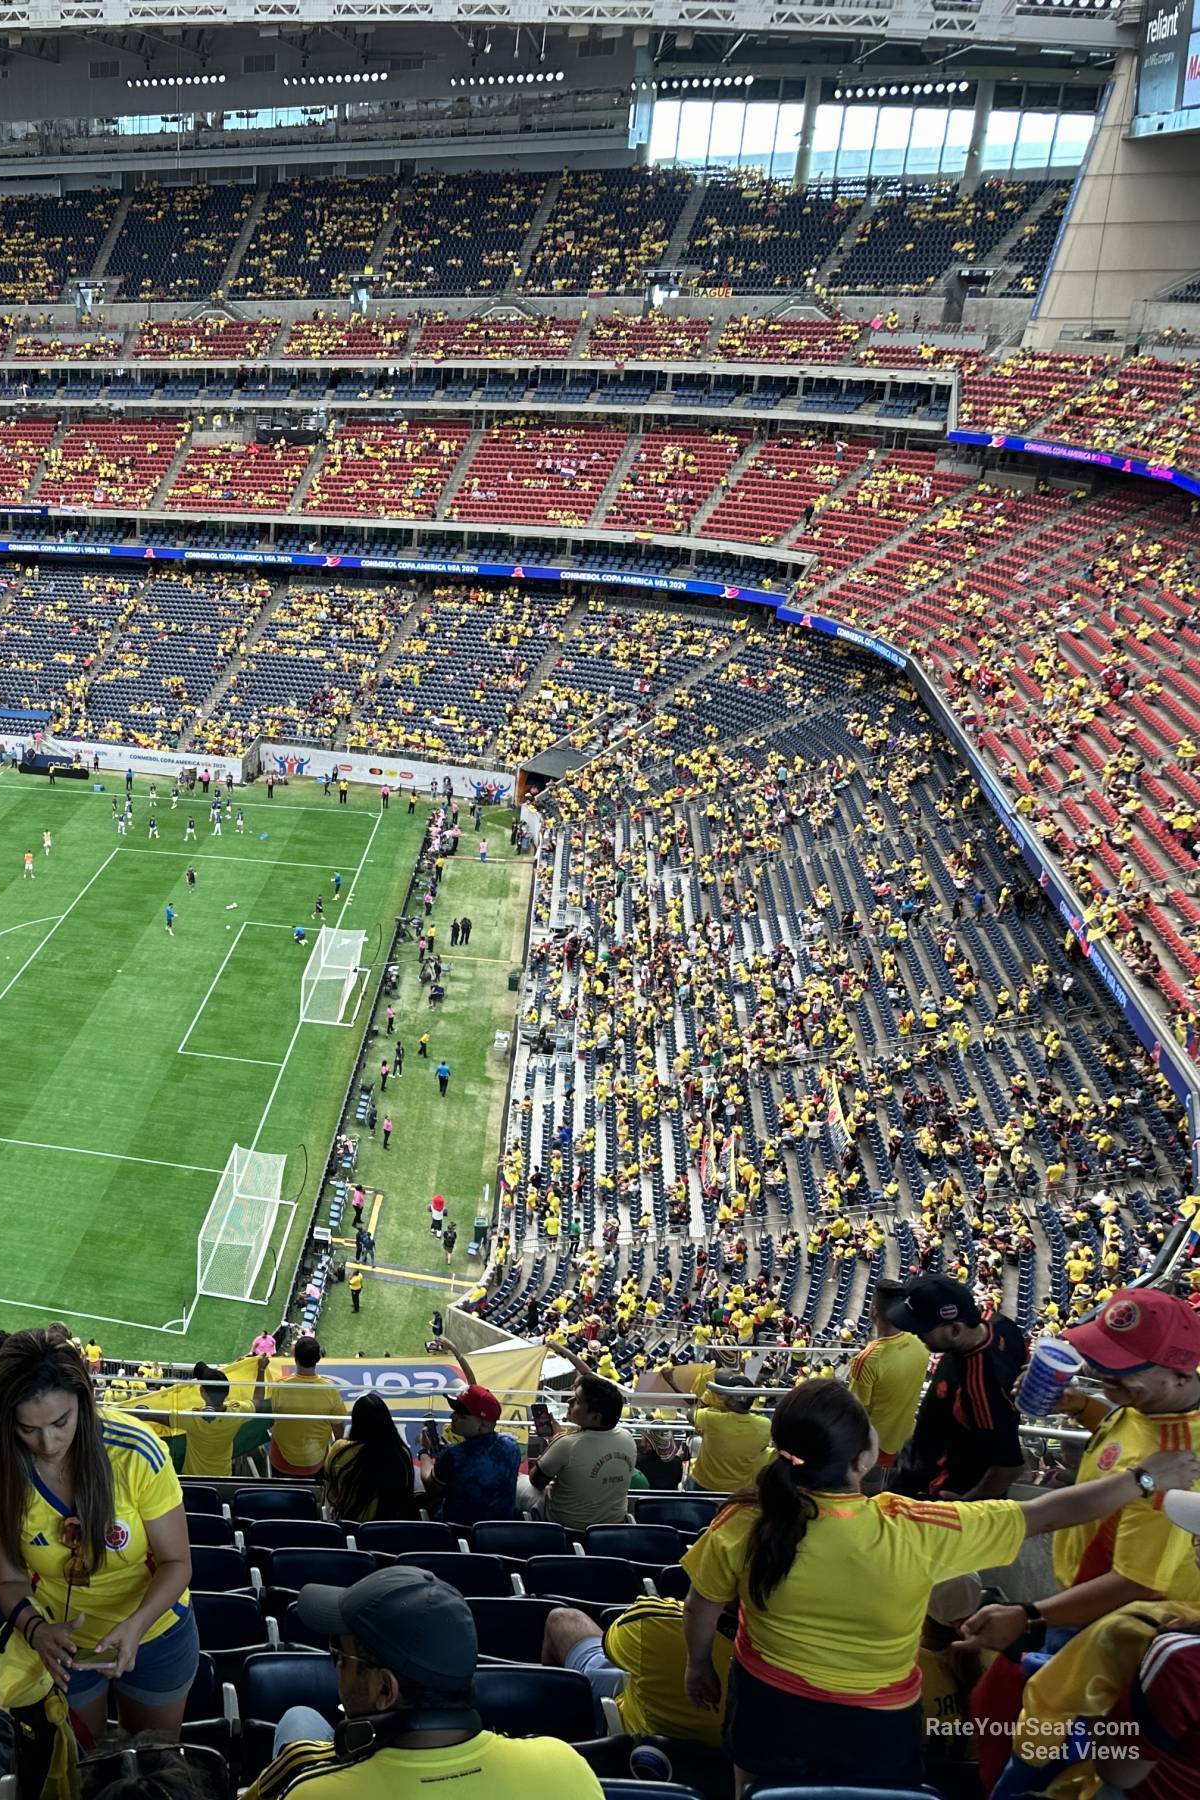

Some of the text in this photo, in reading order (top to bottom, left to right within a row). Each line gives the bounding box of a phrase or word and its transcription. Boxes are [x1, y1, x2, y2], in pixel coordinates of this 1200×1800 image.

[1146, 5, 1179, 44] reliant
[360, 560, 397, 570] CONMEBOL
[397, 561, 416, 571] COPA
[415, 562, 447, 573] AMERICA
[446, 564, 461, 574] USA
[560, 571, 601, 582] CONMEBOL
[601, 574, 622, 584] COPA
[621, 575, 655, 588] AMERICA
[654, 579, 670, 589] USA
